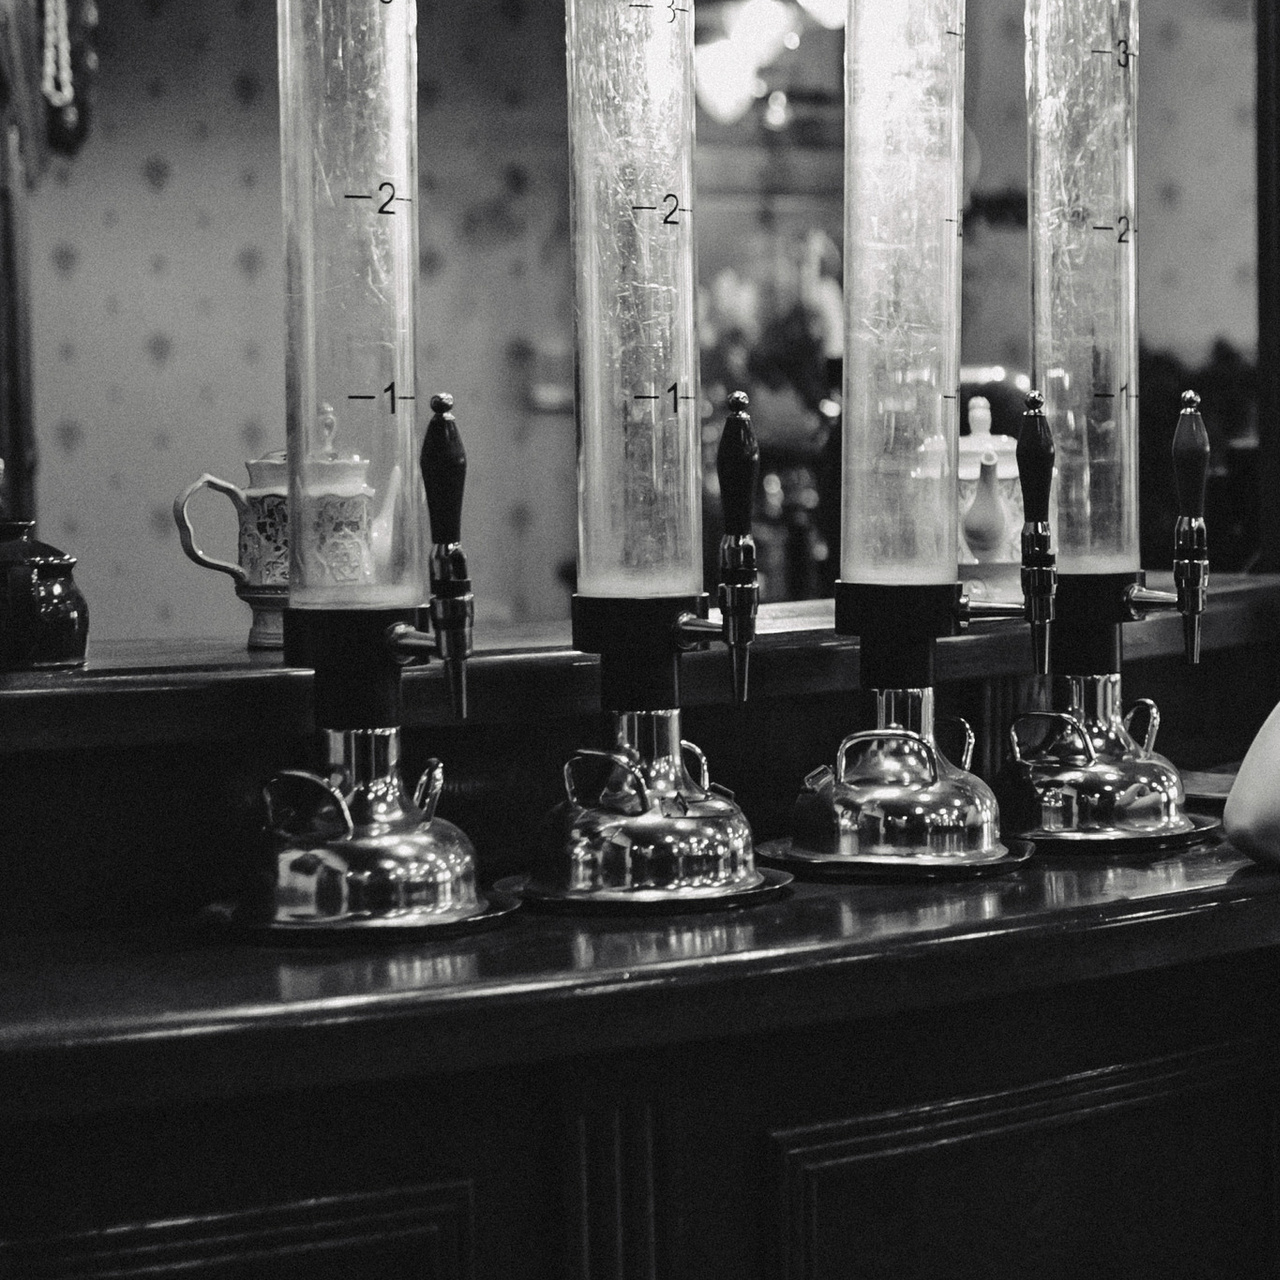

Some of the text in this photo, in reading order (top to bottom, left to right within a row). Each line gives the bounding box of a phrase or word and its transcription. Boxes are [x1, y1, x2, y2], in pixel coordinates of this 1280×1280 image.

[1117, 39, 1129, 68] 3
[378, 182, 396, 215] 2
[663, 194, 679, 224] 2
[1117, 215, 1129, 243] 2
[383, 381, 396, 414] 1
[667, 382, 678, 413] 1
